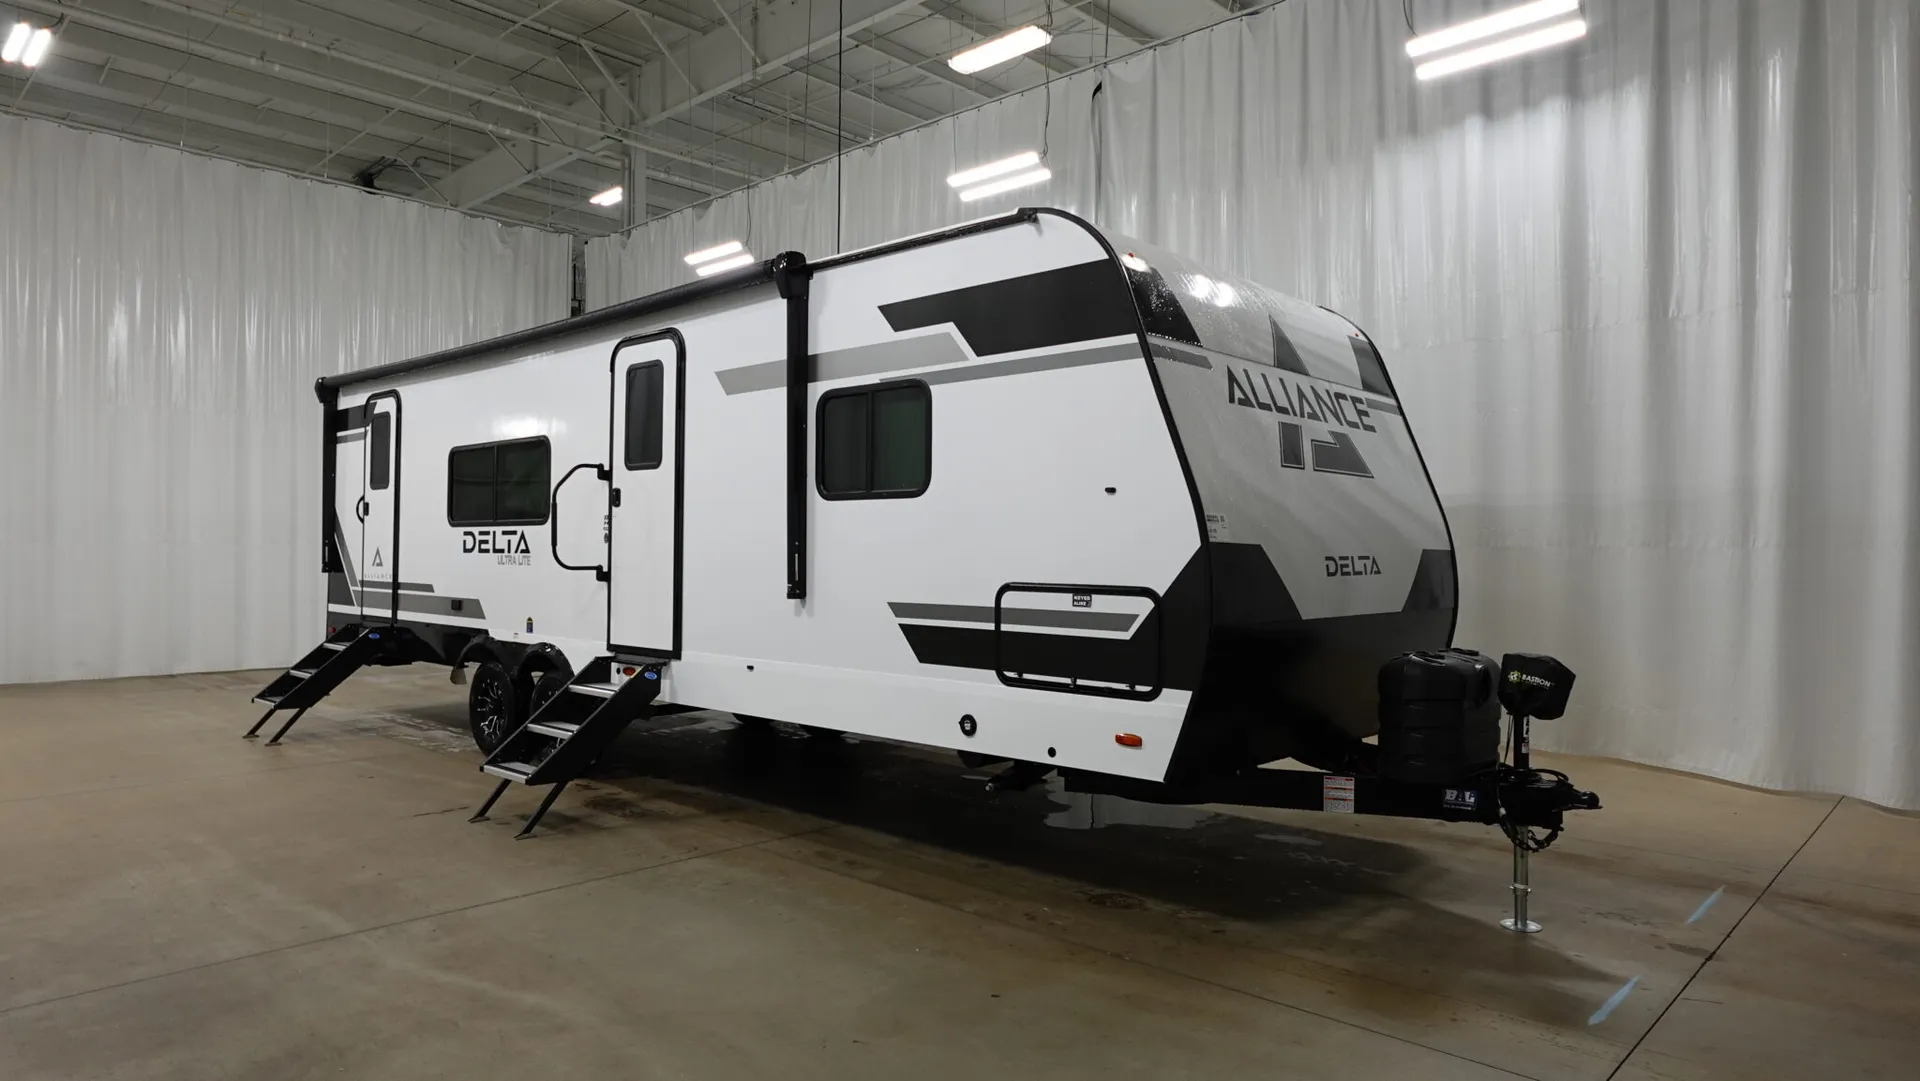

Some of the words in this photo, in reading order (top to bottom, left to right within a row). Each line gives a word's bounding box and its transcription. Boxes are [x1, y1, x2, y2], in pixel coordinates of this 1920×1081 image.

[1226, 364, 1377, 434] ALLIANCE
[462, 530, 531, 554] DELTA
[497, 554, 517, 566] ULTRA
[518, 555, 531, 566] LITE
[1324, 555, 1382, 578] DELTA
[1521, 673, 1551, 688] BASTION
